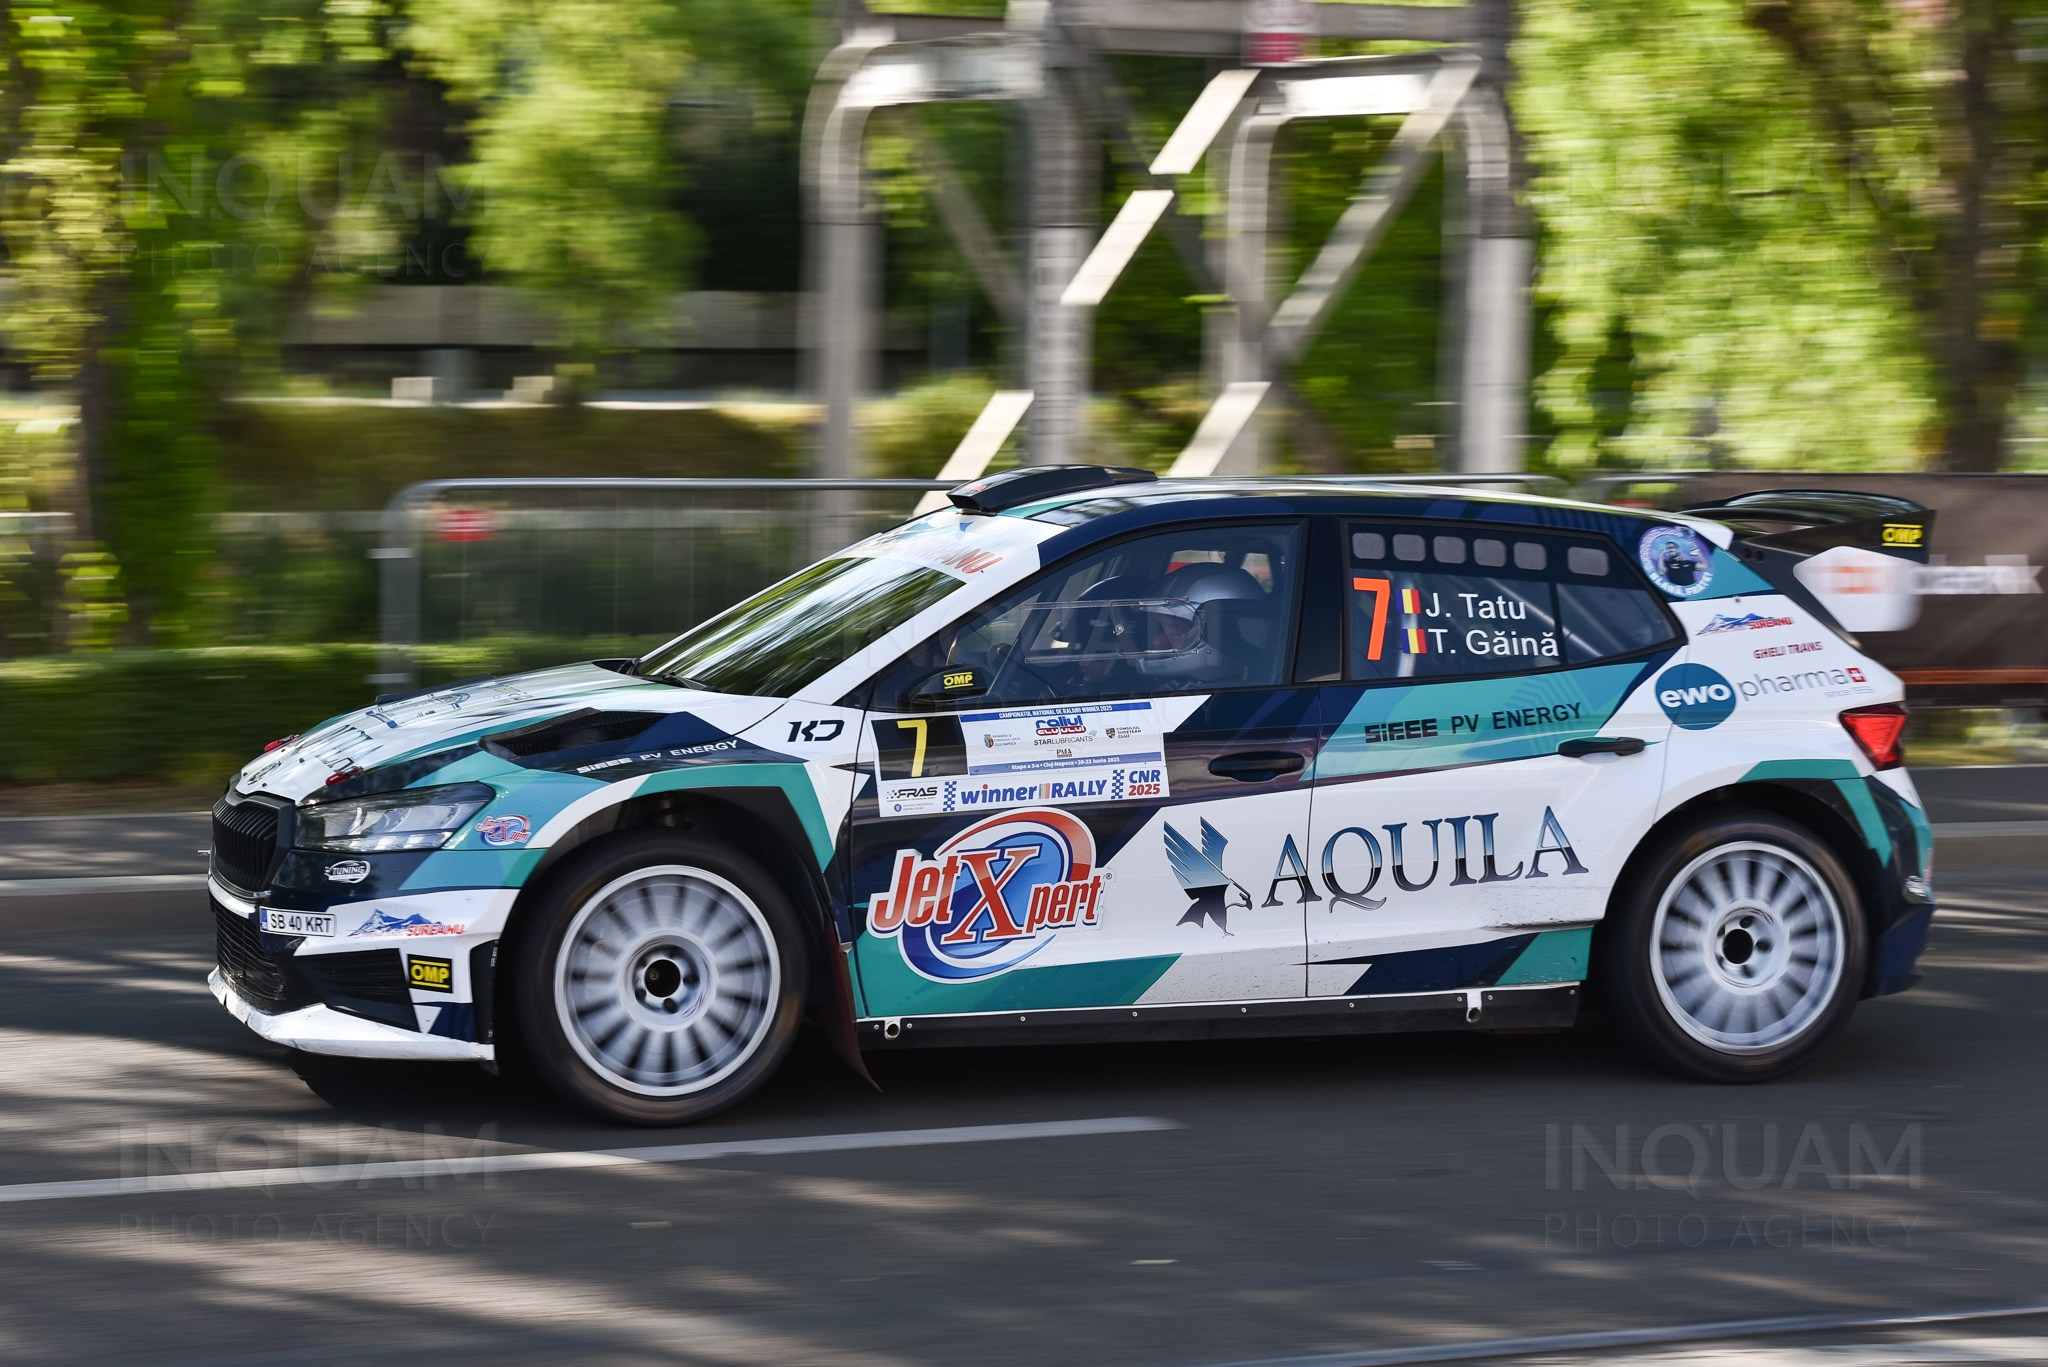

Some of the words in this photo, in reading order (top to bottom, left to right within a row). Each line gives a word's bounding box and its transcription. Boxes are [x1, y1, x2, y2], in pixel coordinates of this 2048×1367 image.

[1882, 528, 1923, 543] OMP
[1425, 593, 1451, 618] J.
[1458, 593, 1527, 620] Tatu
[1353, 577, 1391, 661] 7
[1428, 628, 1456, 654] T.
[1465, 629, 1559, 657] Găină
[1787, 641, 1824, 655] TRANS
[943, 674, 973, 686] OMP
[1660, 683, 1732, 708] ewo
[1737, 667, 1849, 702] pharma
[998, 711, 1033, 719] CAMPIONATUL
[1451, 713, 1479, 734] PV
[1492, 702, 1582, 730] ENERGY
[639, 752, 662, 761] PV
[669, 739, 738, 757] ENERGY
[897, 719, 928, 777] 7
[1043, 760, 1075, 768] Cluj-Napoca
[1129, 770, 1161, 784] CNR
[897, 786, 938, 798] FRAS
[961, 784, 1038, 804] winner
[1051, 779, 1108, 799] RALLY
[1129, 784, 1161, 796] 2025
[331, 865, 368, 876] TUNING
[1261, 805, 1589, 915] AQUILA
[873, 847, 1102, 942] JetXpert
[270, 914, 286, 930] SB
[288, 916, 302, 932] 40
[305, 916, 332, 934] KRT
[411, 964, 450, 985] OMP
